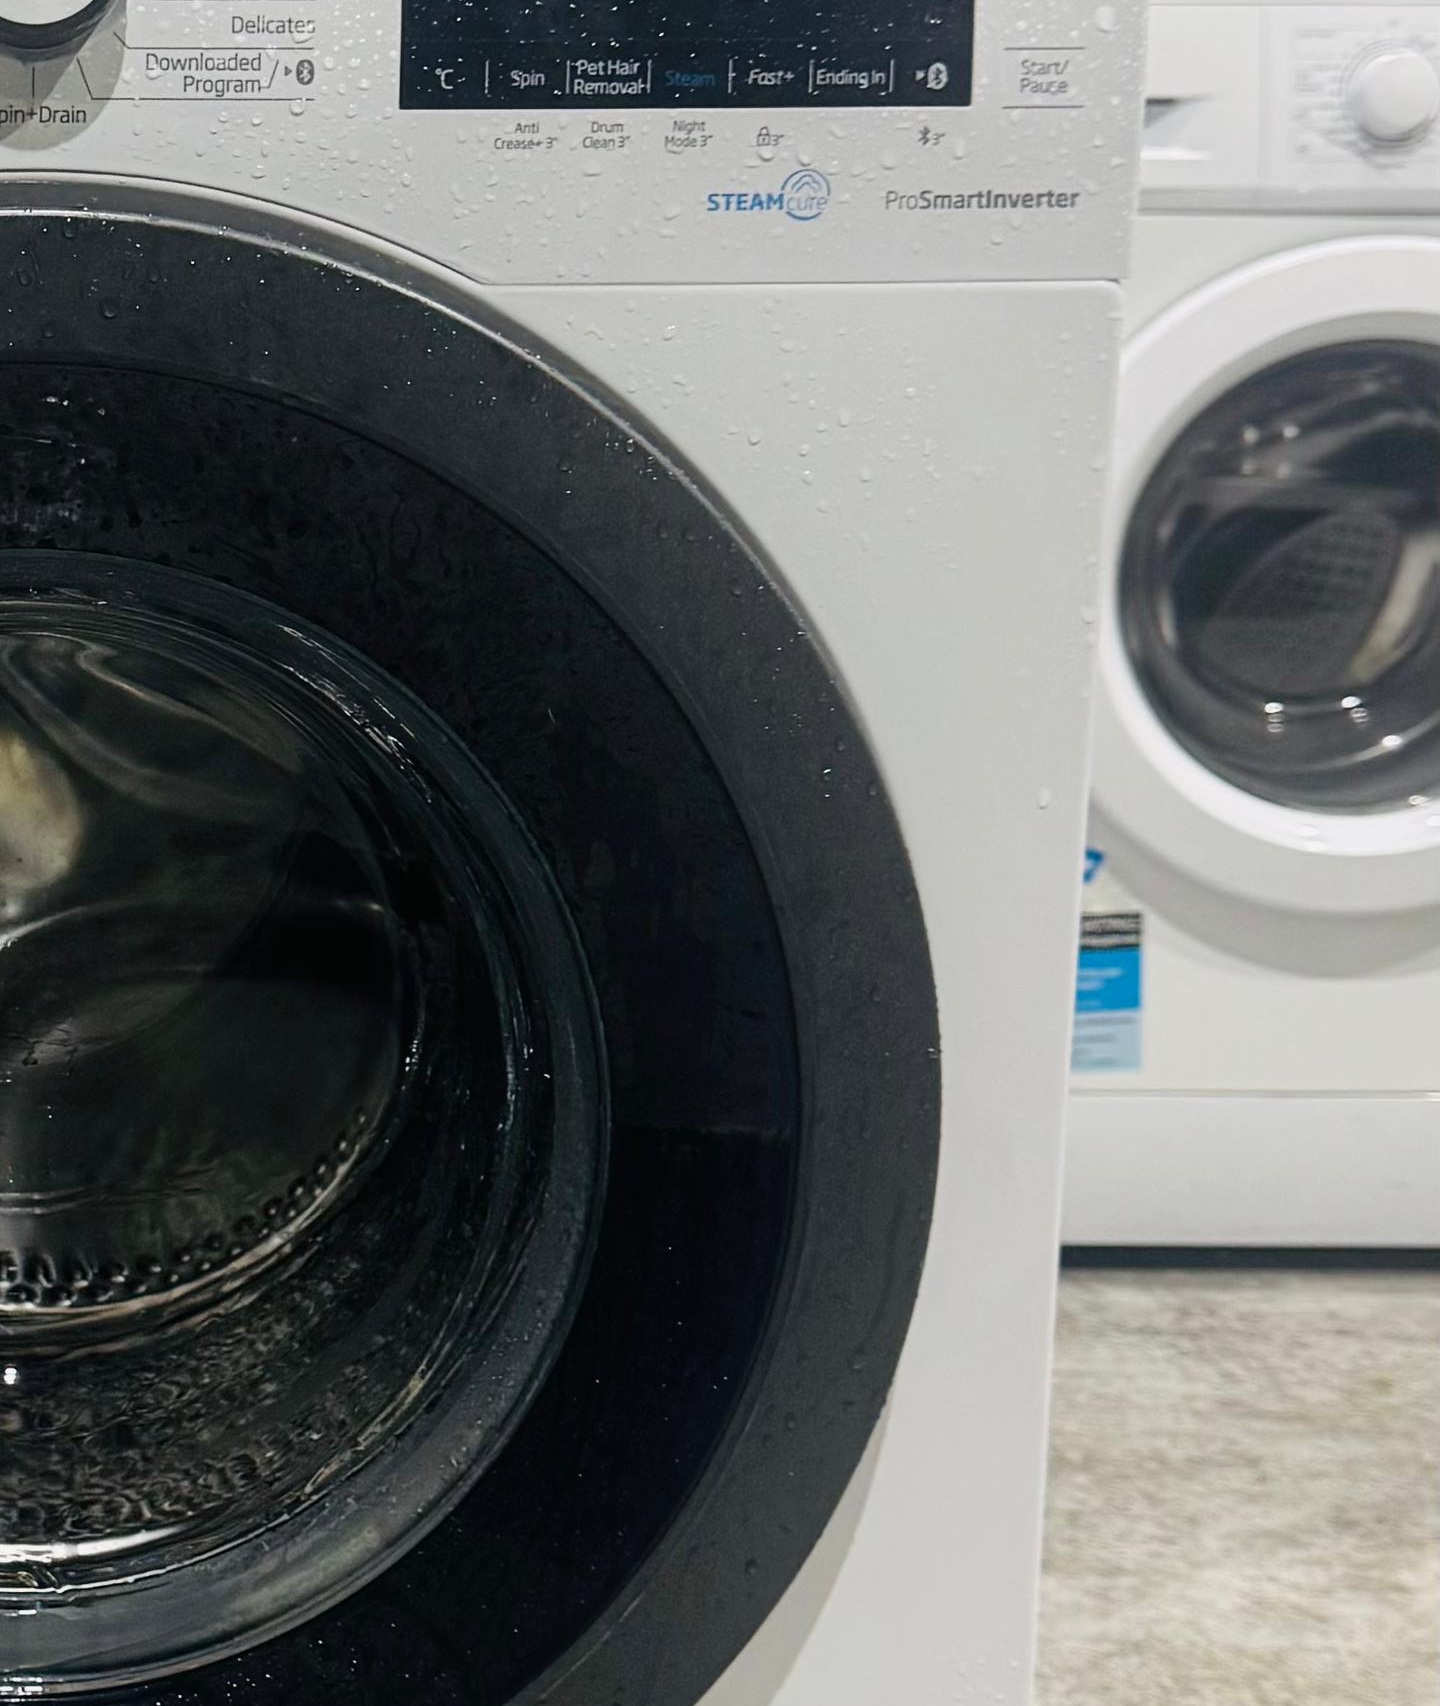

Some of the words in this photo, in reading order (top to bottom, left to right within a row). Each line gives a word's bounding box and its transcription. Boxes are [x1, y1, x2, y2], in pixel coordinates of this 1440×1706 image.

[231, 15, 316, 34] Delicates
[145, 53, 262, 72] Downloaded
[577, 60, 606, 75] Pet
[608, 60, 640, 75] Hair
[1020, 59, 1069, 76] Start/
[511, 69, 546, 89] Spin
[664, 70, 715, 86] Steam
[748, 69, 795, 86] Fast+
[816, 70, 869, 88] Ending
[871, 70, 885, 84] In
[183, 75, 261, 97] Program
[574, 79, 643, 94] Removal
[1020, 79, 1068, 95] Pause
[515, 121, 540, 134] Anti
[590, 121, 624, 134] Drum
[673, 119, 707, 135] Night
[582, 136, 616, 149] Clean
[664, 135, 698, 147] Mode
[885, 190, 1081, 211] ProSmartInverter
